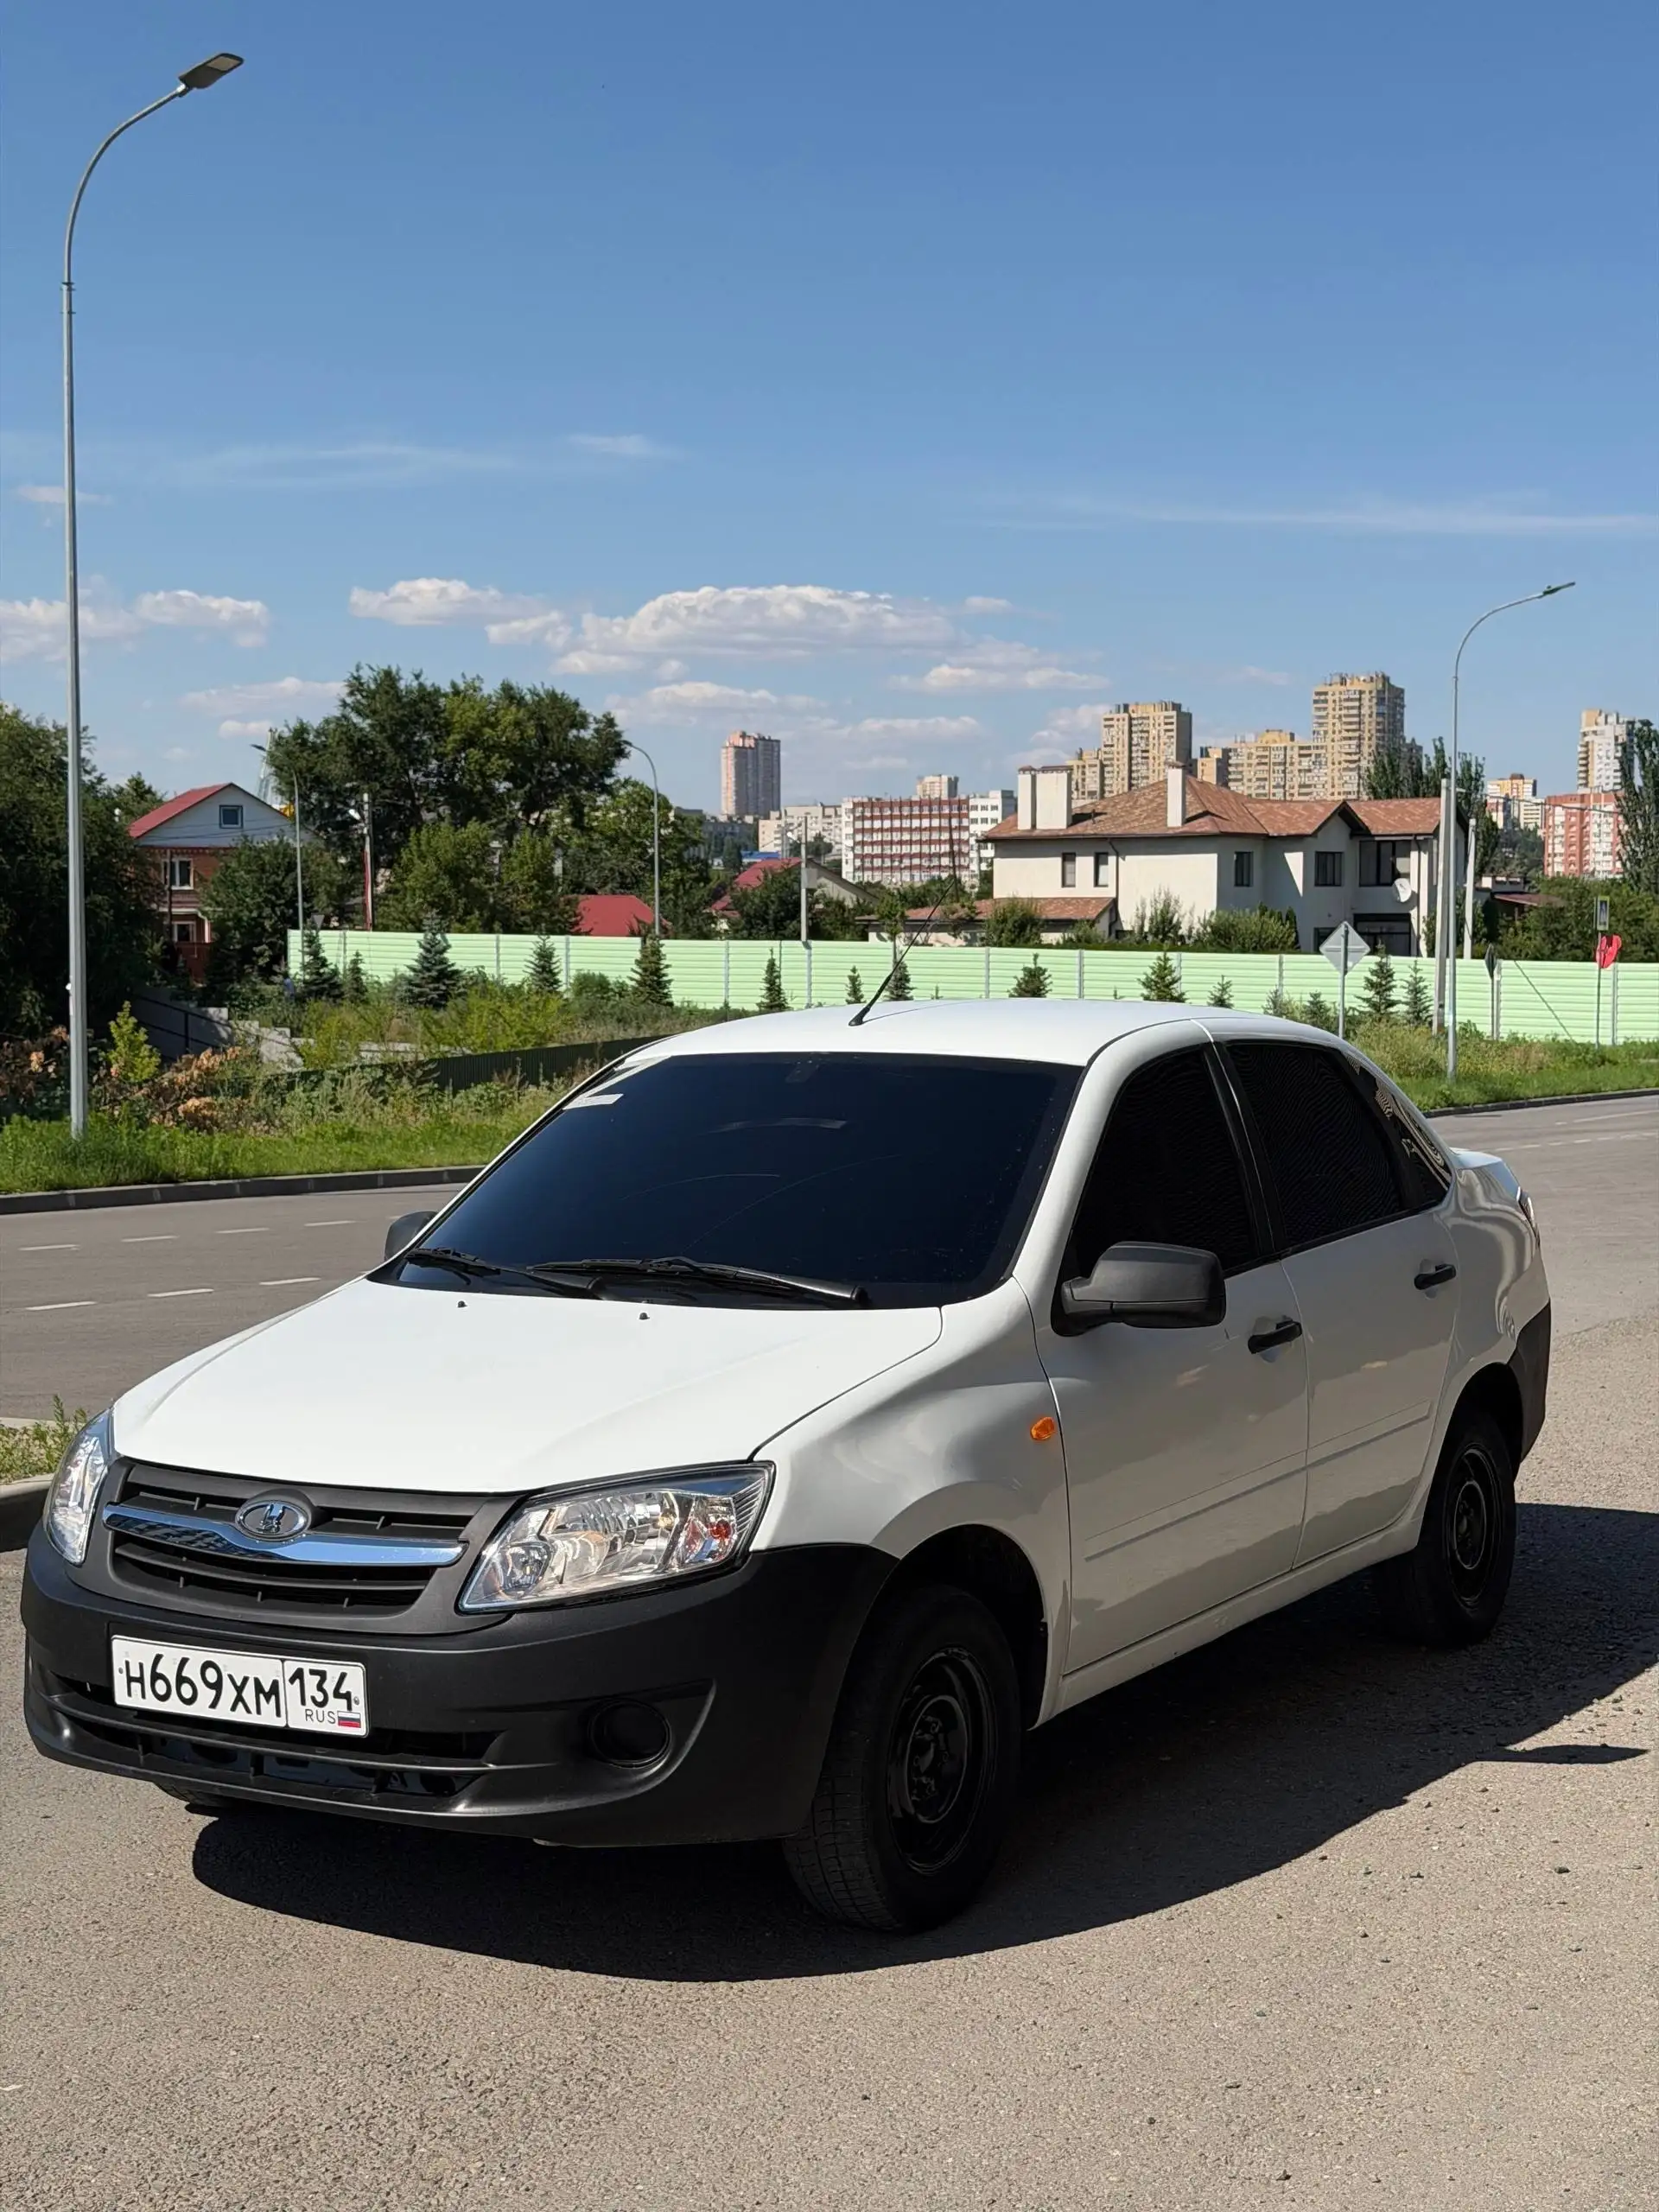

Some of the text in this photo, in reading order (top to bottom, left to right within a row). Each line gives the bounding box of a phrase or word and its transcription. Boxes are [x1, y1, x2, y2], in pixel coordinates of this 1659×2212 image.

[124, 1653, 353, 1718] Н669ХМ 134
[305, 1708, 336, 1725] RUS
